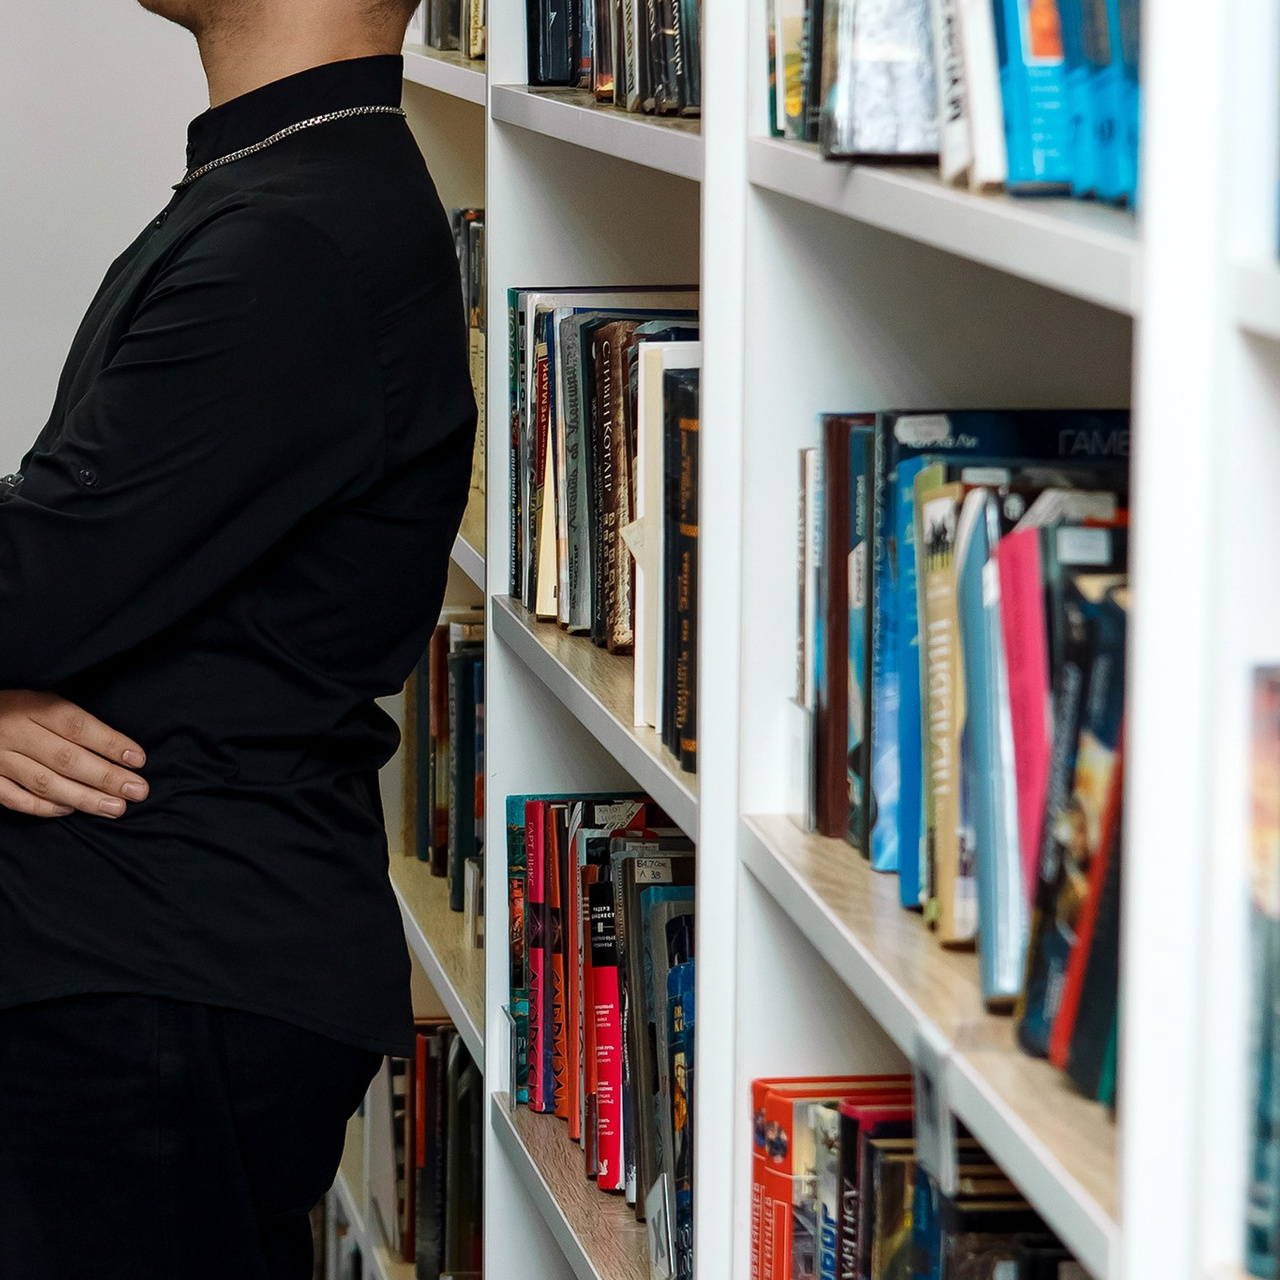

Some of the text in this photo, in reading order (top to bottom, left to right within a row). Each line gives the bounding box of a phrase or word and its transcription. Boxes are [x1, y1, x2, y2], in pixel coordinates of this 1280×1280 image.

[540, 362, 550, 424] РЕМАРК
[509, 448, 518, 505] прицелом
[603, 420, 612, 492] КОТЛЕР
[527, 821, 535, 887] ГАРТ НИКС
